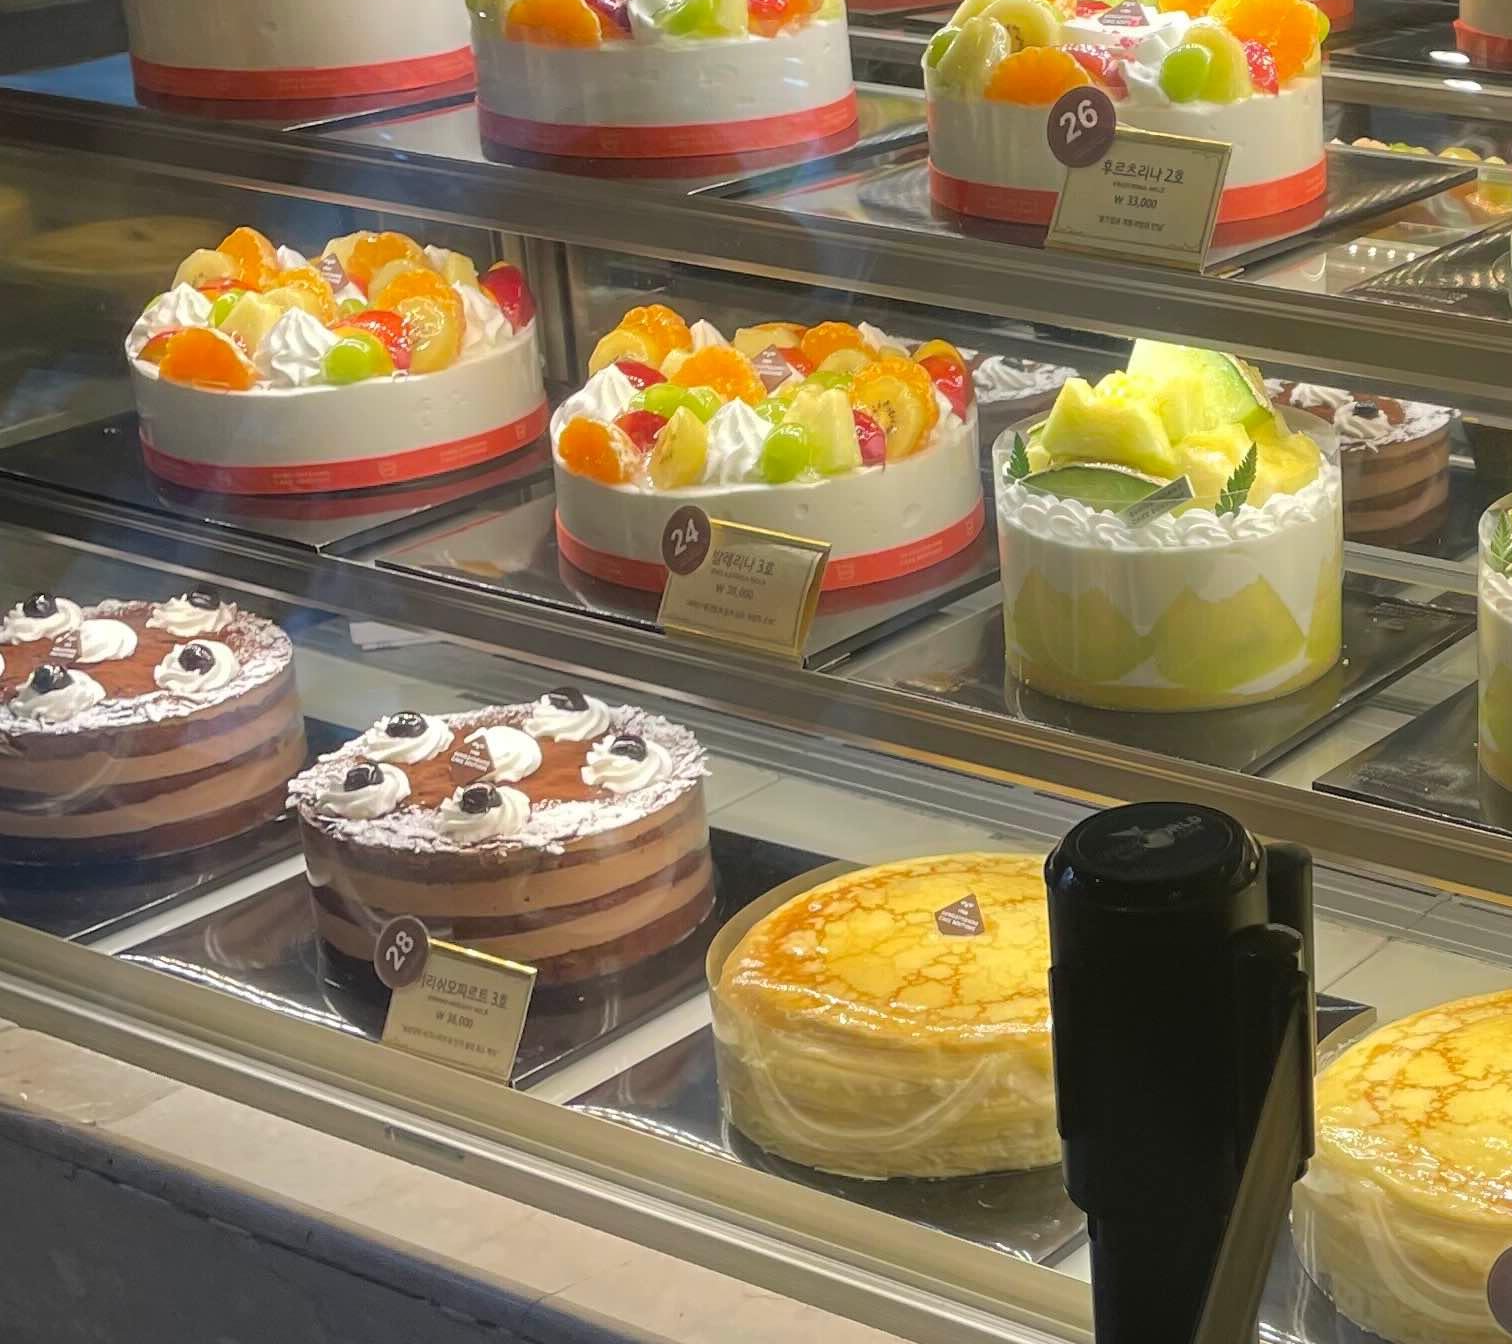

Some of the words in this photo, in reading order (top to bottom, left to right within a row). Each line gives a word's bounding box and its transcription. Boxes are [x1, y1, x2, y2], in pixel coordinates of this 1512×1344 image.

[1059, 99, 1098, 144] 26
[1102, 159, 1163, 182] 후르츠리나
[1164, 168, 1185, 185] 2호
[1127, 195, 1158, 209] 33,000
[671, 518, 699, 556] 24
[386, 931, 414, 971] 28
